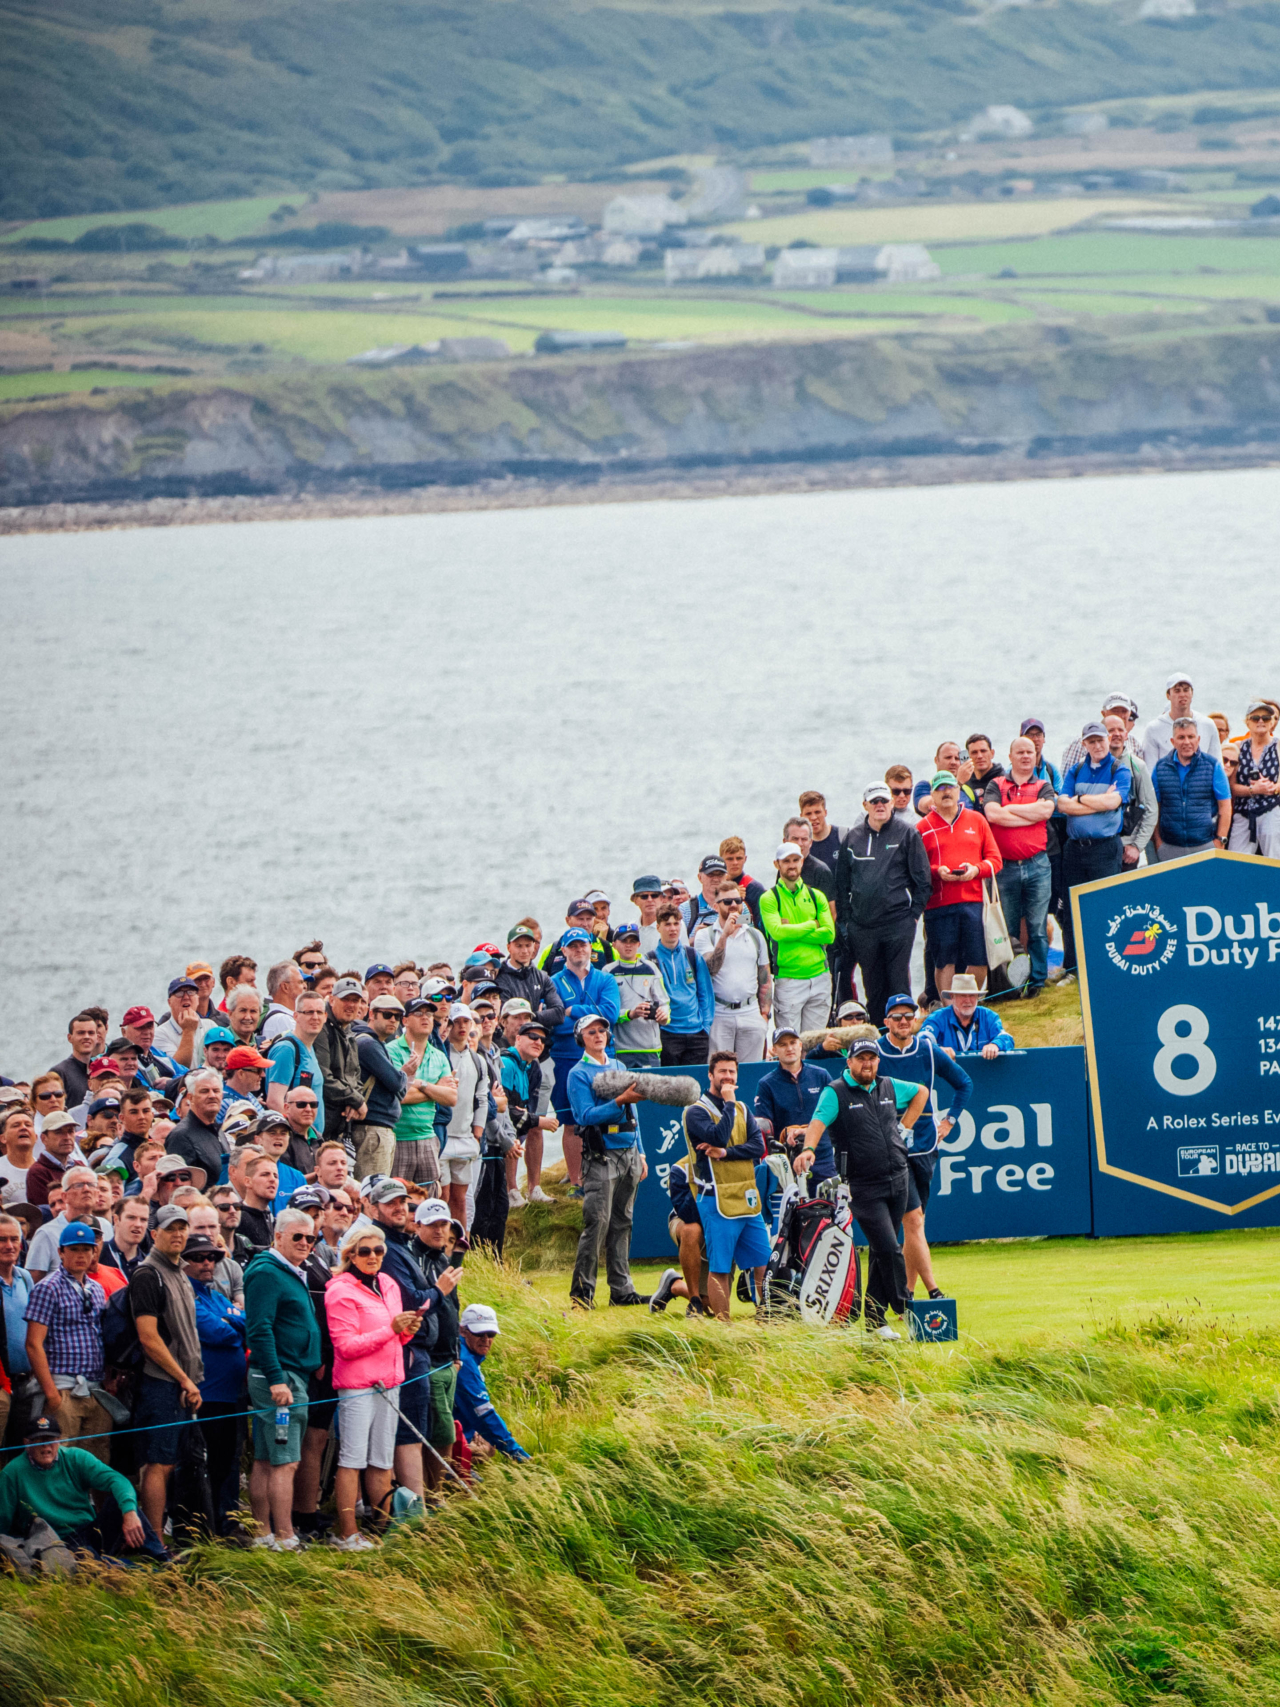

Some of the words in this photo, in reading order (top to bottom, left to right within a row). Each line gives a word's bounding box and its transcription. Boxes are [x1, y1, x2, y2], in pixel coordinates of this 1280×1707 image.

[1105, 942, 1129, 971] DUBAI
[1131, 960, 1161, 975] DUTY
[1160, 938, 1177, 965] FREE
[1185, 942, 1259, 969] Duty
[1153, 1004, 1217, 1096] 8
[1146, 1116, 1159, 1130] A
[1163, 1114, 1207, 1129] Rolex
[1211, 1111, 1259, 1127] Series
[1235, 1143, 1256, 1152] RACE
[1258, 1142, 1269, 1151] TO
[937, 1156, 1055, 1195] Free
[1225, 1152, 1280, 1176] DUBAI
